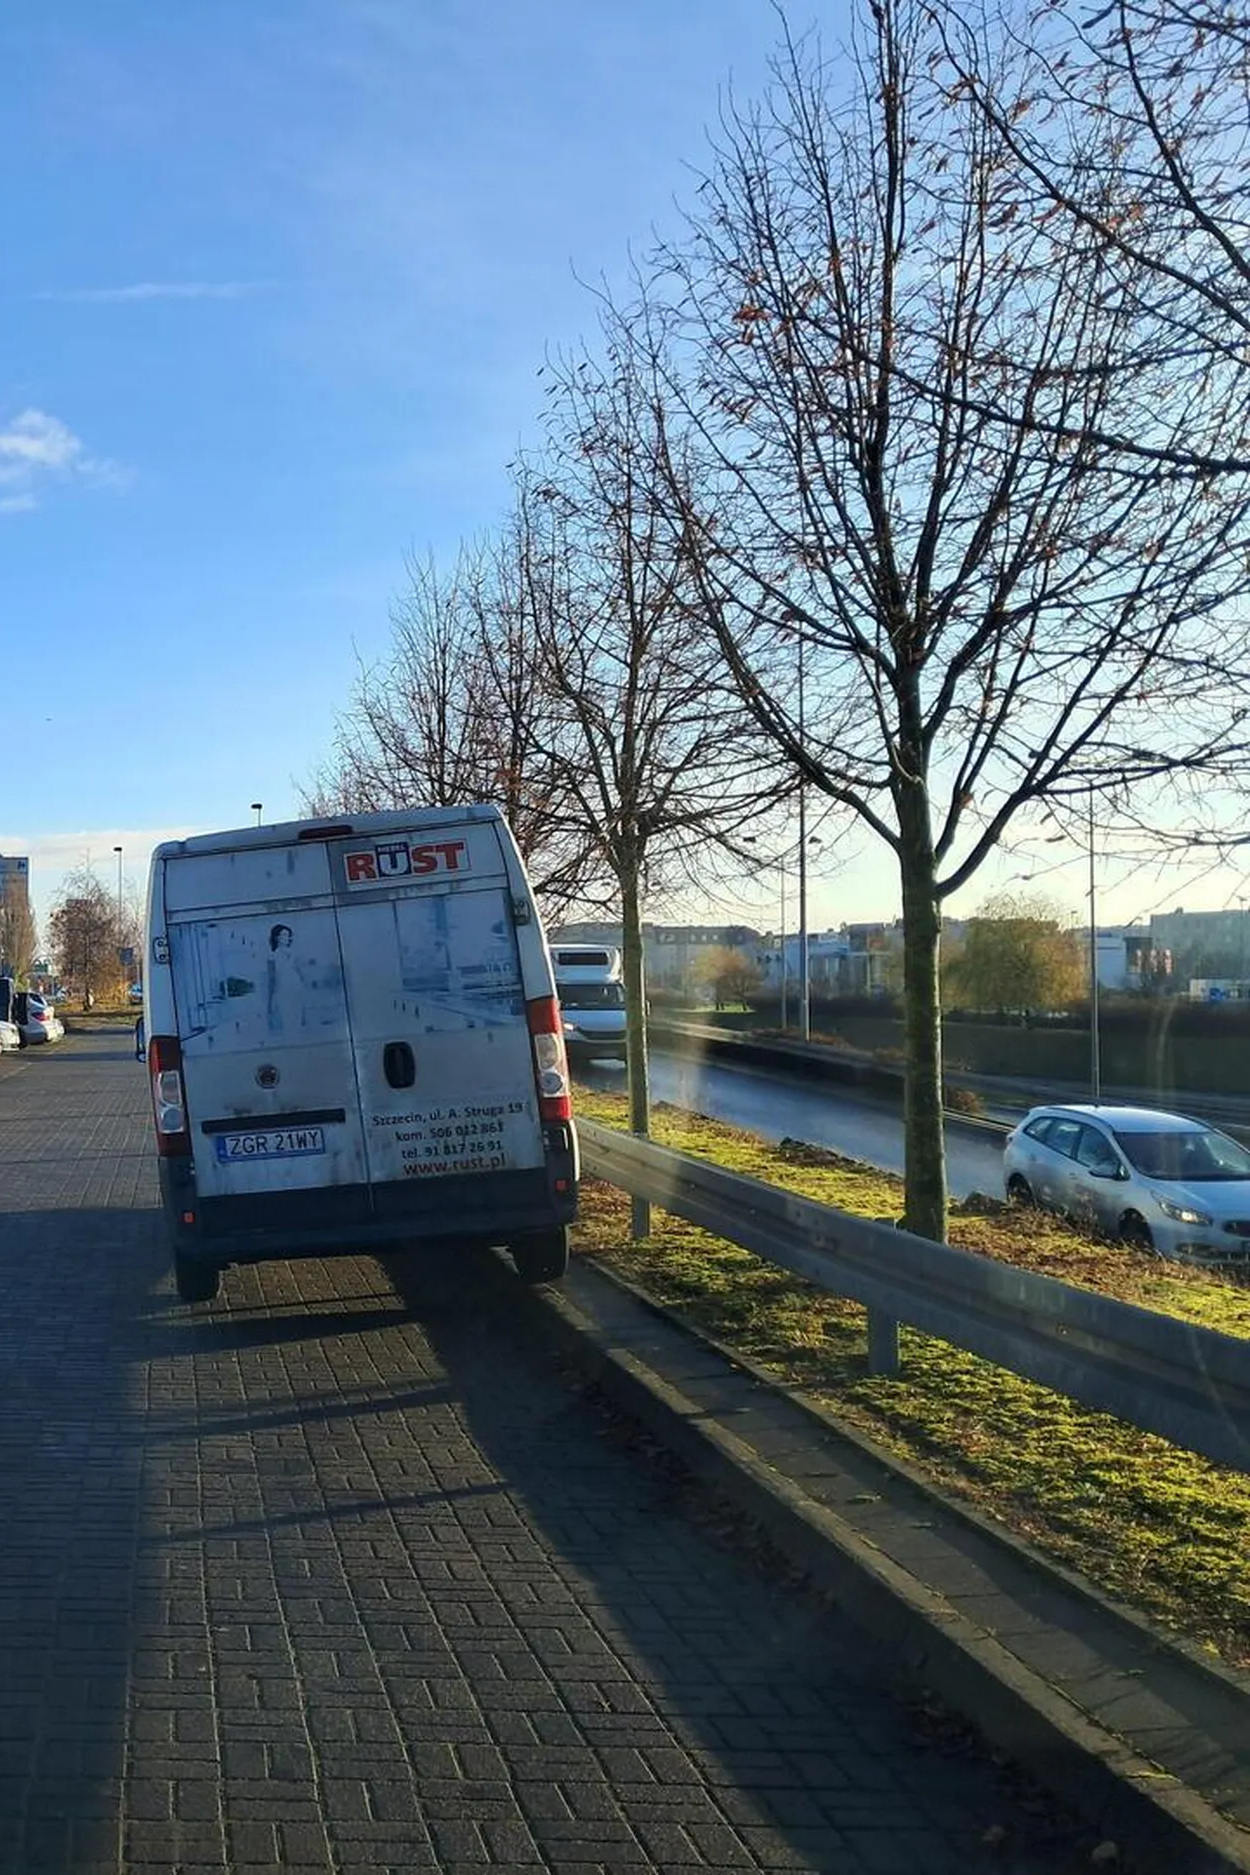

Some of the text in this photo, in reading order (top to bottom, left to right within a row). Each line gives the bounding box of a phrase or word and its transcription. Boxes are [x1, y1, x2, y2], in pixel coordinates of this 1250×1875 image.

[372, 1110, 427, 1126] Szczecin,
[448, 1108, 461, 1119] A.
[464, 1105, 504, 1118] Struga
[230, 1131, 318, 1155] ZGR 21WY
[394, 1130, 427, 1142] kom.
[430, 1126, 453, 1139] 506
[455, 1124, 479, 1136] 012
[402, 1148, 422, 1160] tel.
[425, 1145, 439, 1157] 91
[403, 1153, 506, 1175] www.rust.pl
